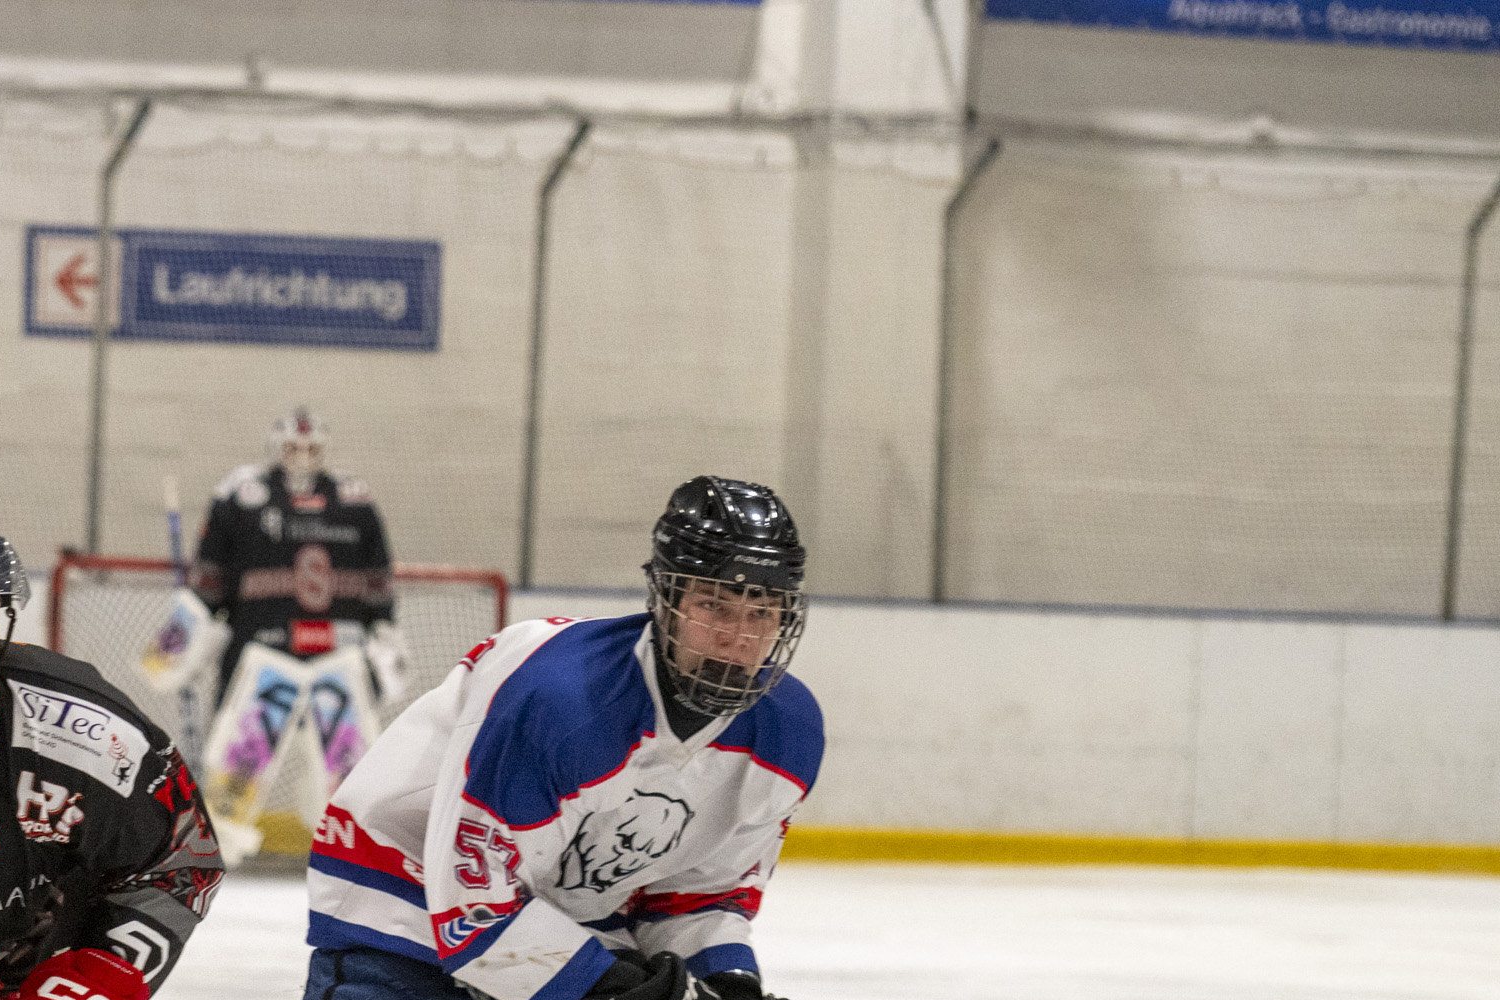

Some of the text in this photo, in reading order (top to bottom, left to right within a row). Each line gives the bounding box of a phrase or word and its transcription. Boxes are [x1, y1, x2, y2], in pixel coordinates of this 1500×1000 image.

[152, 263, 407, 321] Laufrichtung
[19, 687, 111, 741] SiTec
[454, 817, 522, 890] 57
